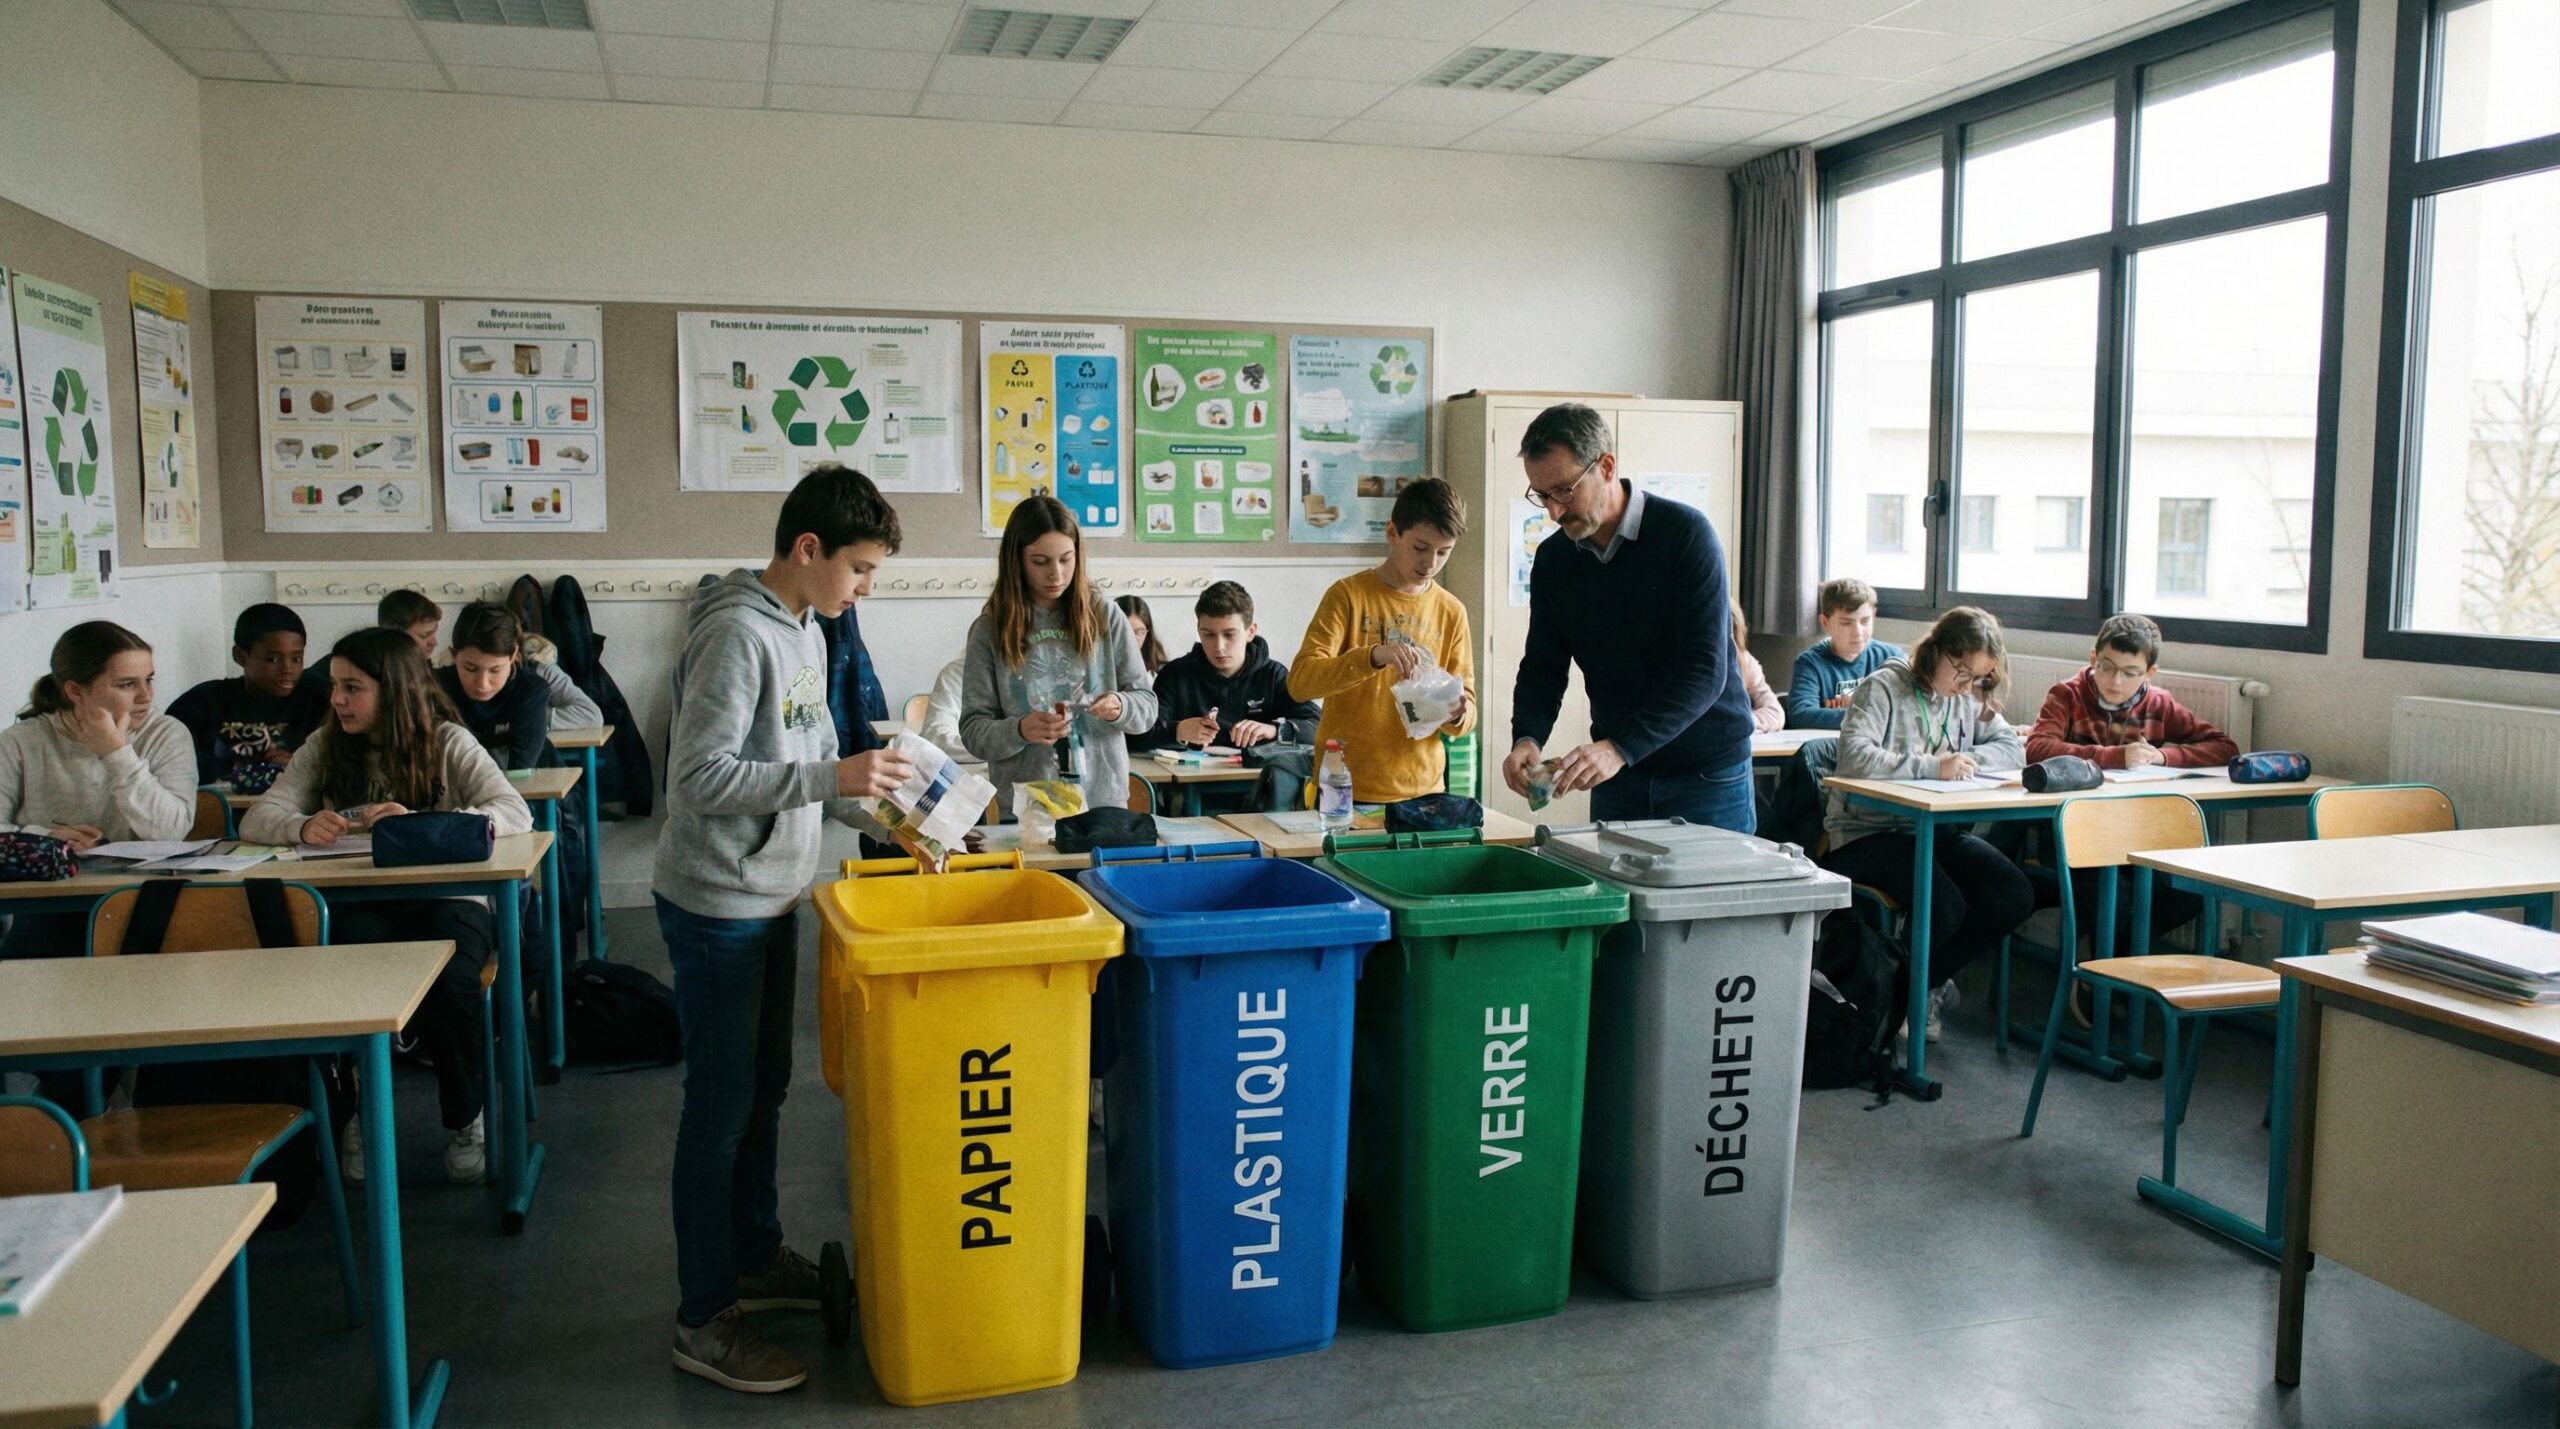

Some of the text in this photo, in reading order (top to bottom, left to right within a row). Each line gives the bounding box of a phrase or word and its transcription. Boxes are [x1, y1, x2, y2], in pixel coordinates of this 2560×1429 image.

[960, 1043, 1012, 1250] PAPIER
[1232, 988, 1288, 1290] PLASTIQUE
[1479, 1003, 1529, 1178] VERRE
[1695, 974, 1757, 1197] DÉCHETS
